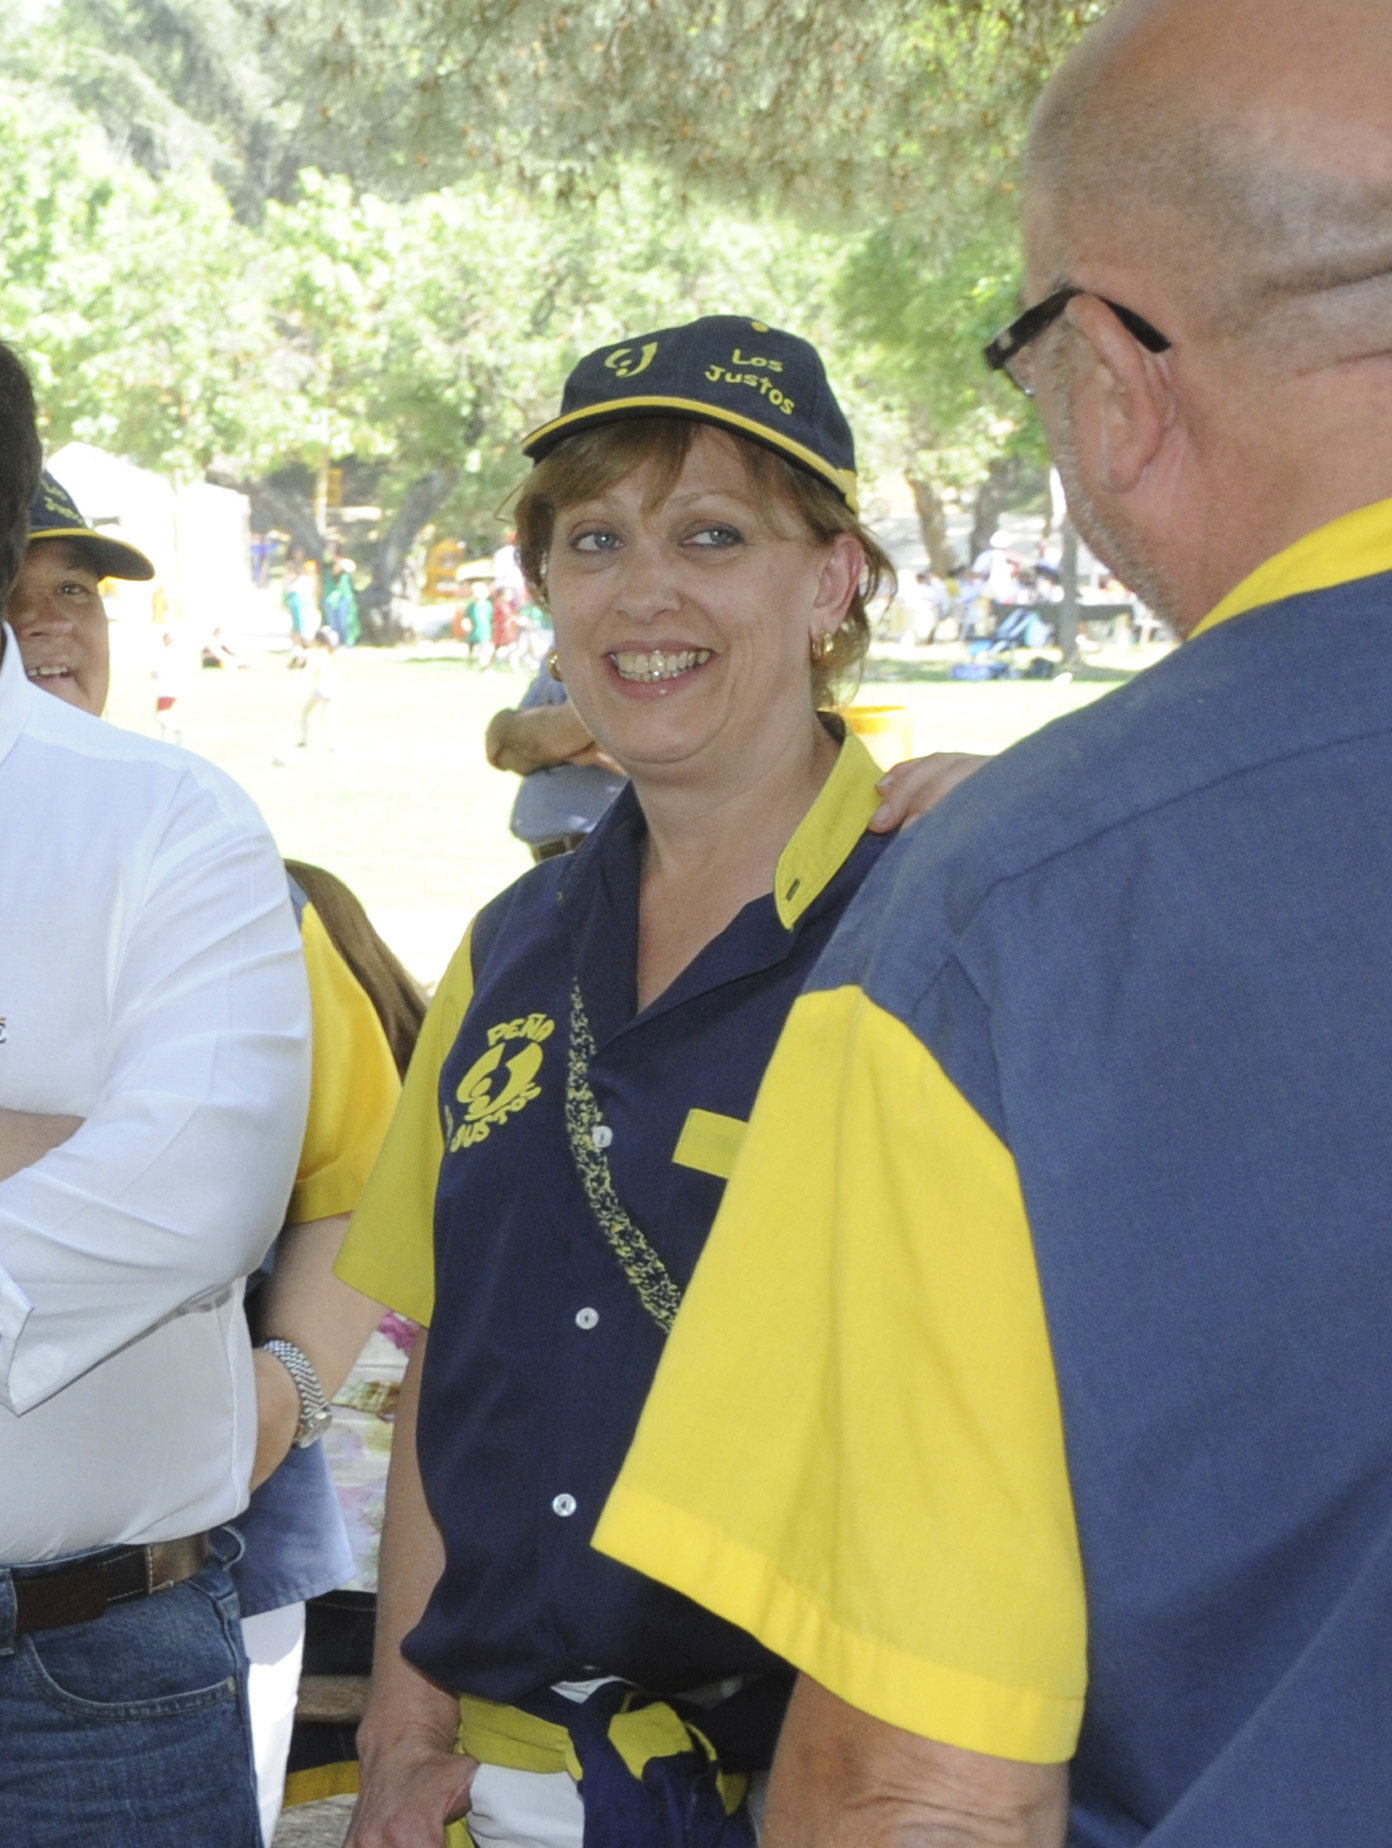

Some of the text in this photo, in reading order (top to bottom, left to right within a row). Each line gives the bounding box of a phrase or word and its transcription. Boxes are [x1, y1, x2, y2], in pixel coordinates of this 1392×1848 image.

[732, 348, 784, 373] Los
[705, 364, 795, 415] Justos
[487, 1013, 555, 1047] PEÑA
